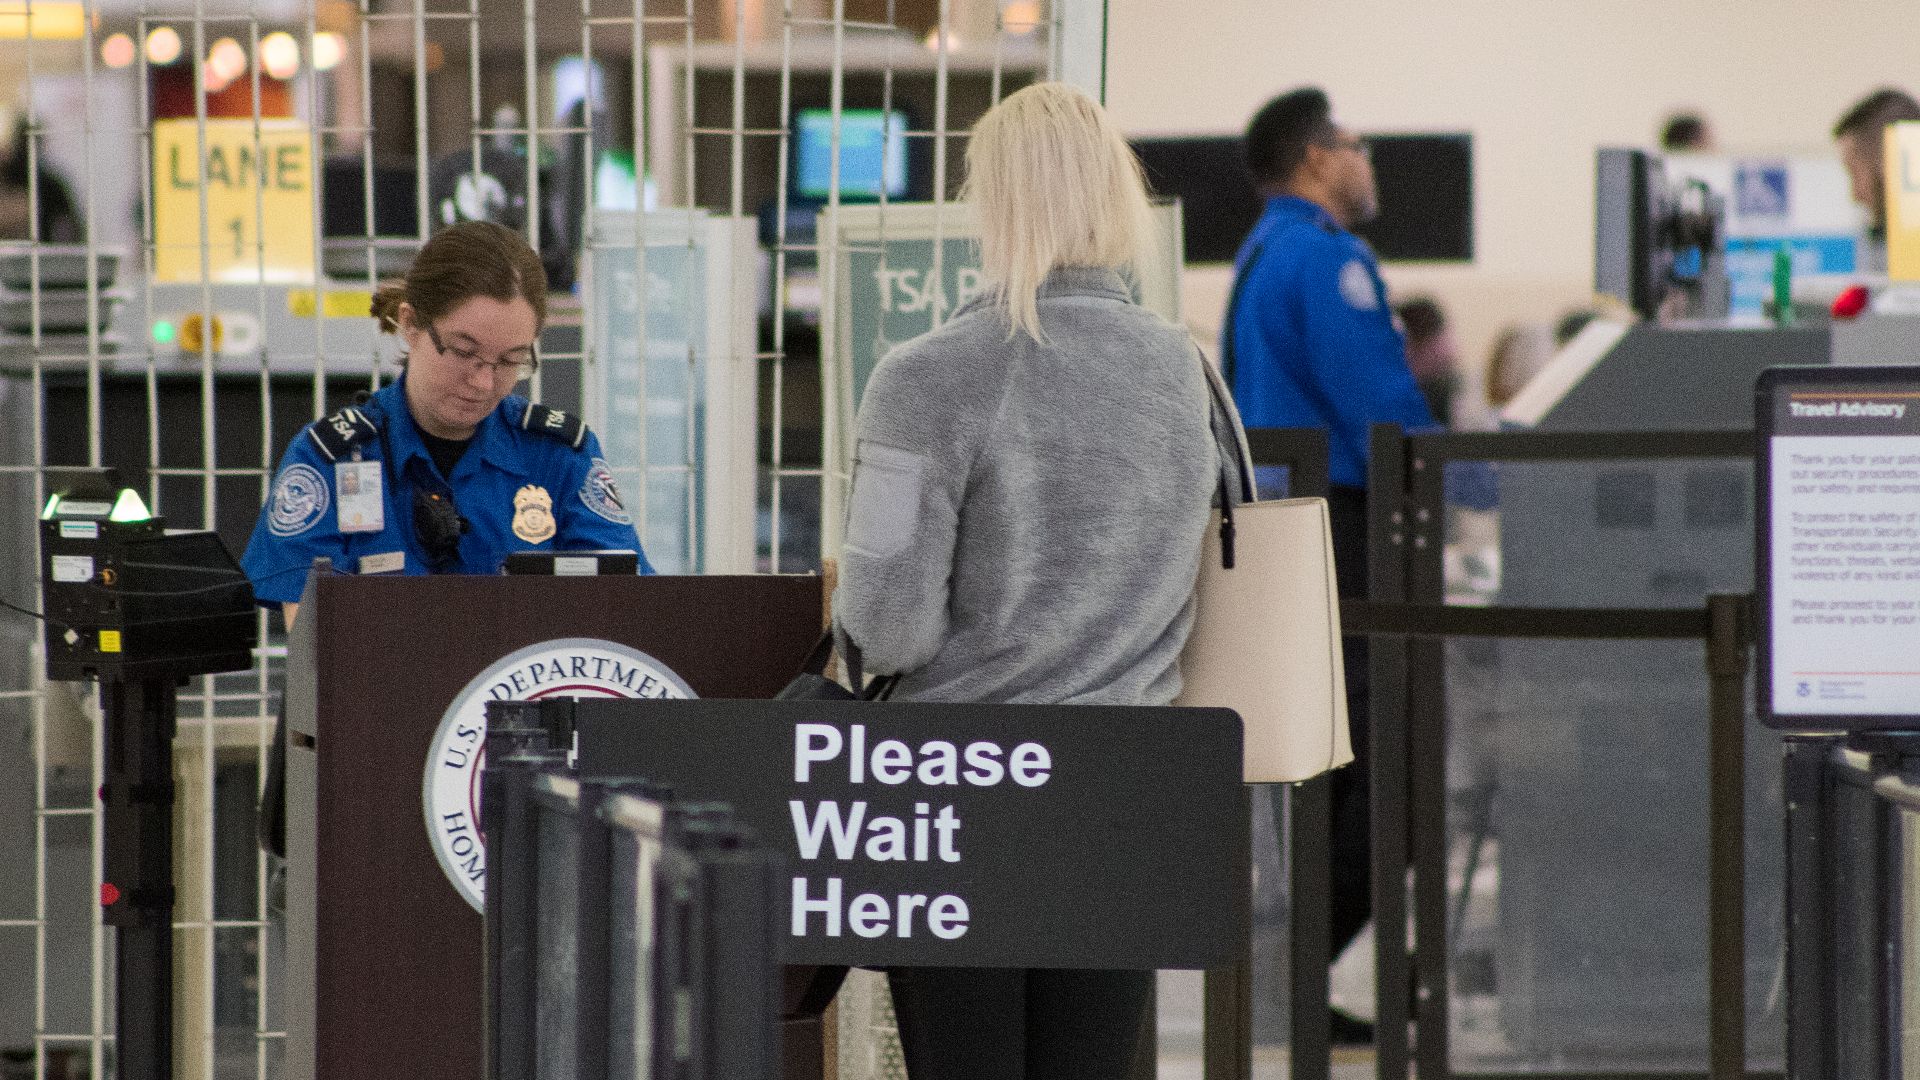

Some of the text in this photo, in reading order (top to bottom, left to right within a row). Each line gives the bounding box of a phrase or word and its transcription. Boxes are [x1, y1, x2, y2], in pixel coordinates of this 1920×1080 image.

[170, 144, 304, 190] LANE
[228, 217, 244, 258] 1
[873, 267, 949, 313] TSA
[328, 411, 356, 441] TSA
[1789, 401, 1906, 418] Travel Advisory
[444, 723, 483, 769] U.S.
[794, 723, 1052, 788] Please
[443, 811, 486, 892] HOM
[789, 800, 961, 863] Wait
[791, 877, 970, 940] Here
